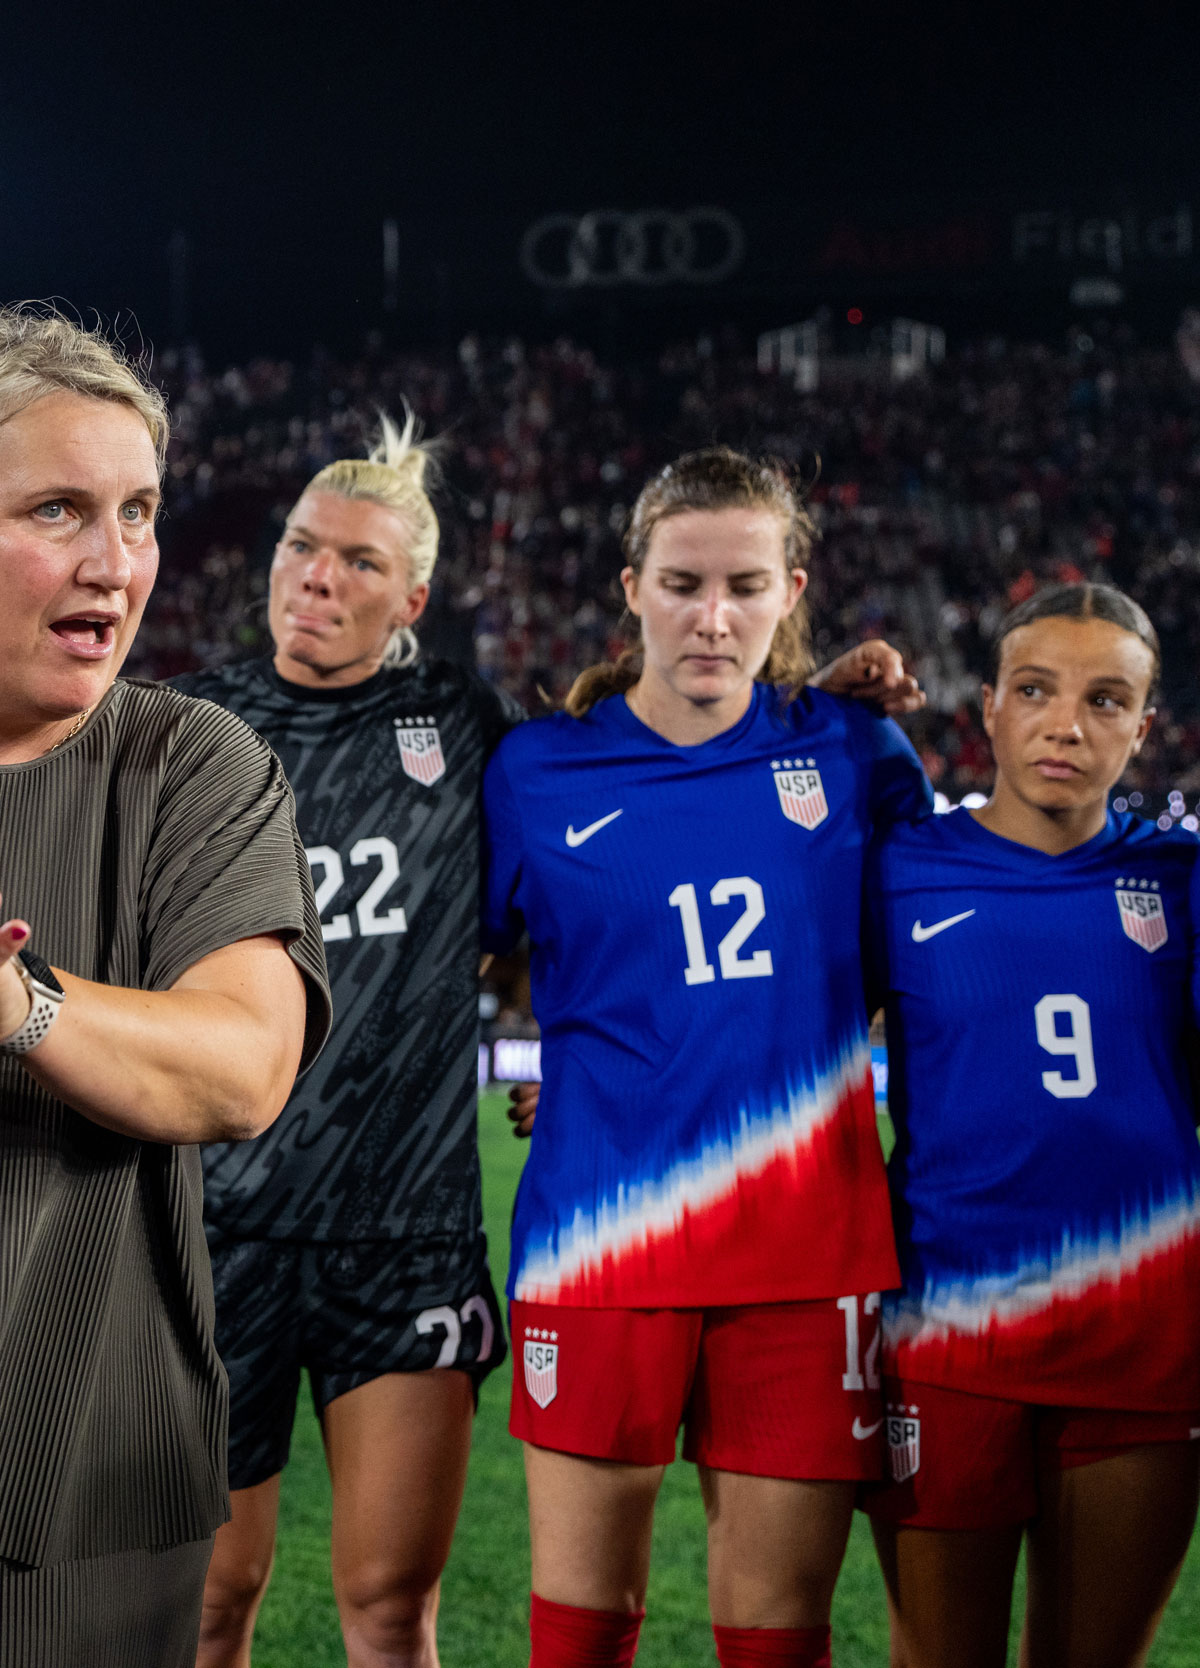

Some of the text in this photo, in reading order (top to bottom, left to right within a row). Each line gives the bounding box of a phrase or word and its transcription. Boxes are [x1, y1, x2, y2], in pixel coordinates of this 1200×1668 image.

[400, 731, 437, 753] USA
[780, 773, 818, 795] USA
[305, 836, 408, 942] 22
[1121, 895, 1159, 918] USA
[668, 876, 774, 986] 12
[1034, 993, 1098, 1099] 9
[525, 1345, 554, 1370] USA
[890, 1421, 916, 1444] SA
